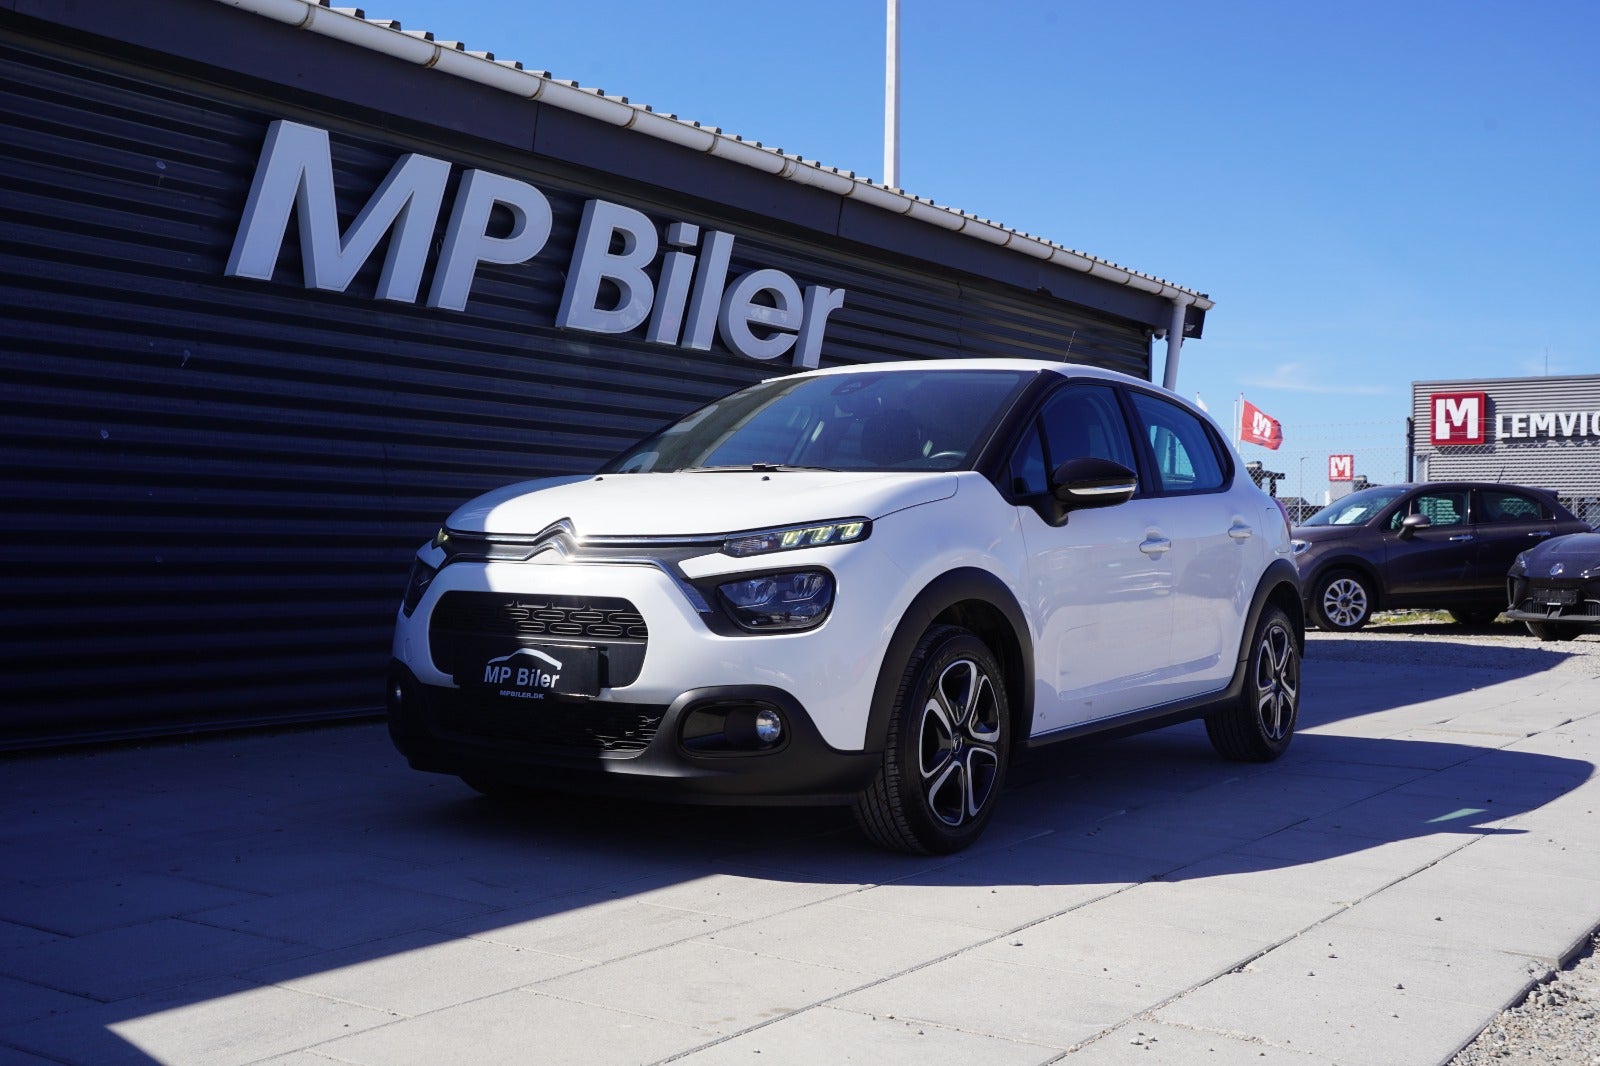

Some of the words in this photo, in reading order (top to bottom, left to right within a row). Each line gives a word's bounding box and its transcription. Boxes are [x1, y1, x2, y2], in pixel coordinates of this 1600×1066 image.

[224, 119, 552, 312] MP
[555, 198, 845, 369] Biler
[484, 665, 511, 684] MP
[516, 667, 560, 689] Biler
[499, 690, 545, 700] MPBILER.DK
